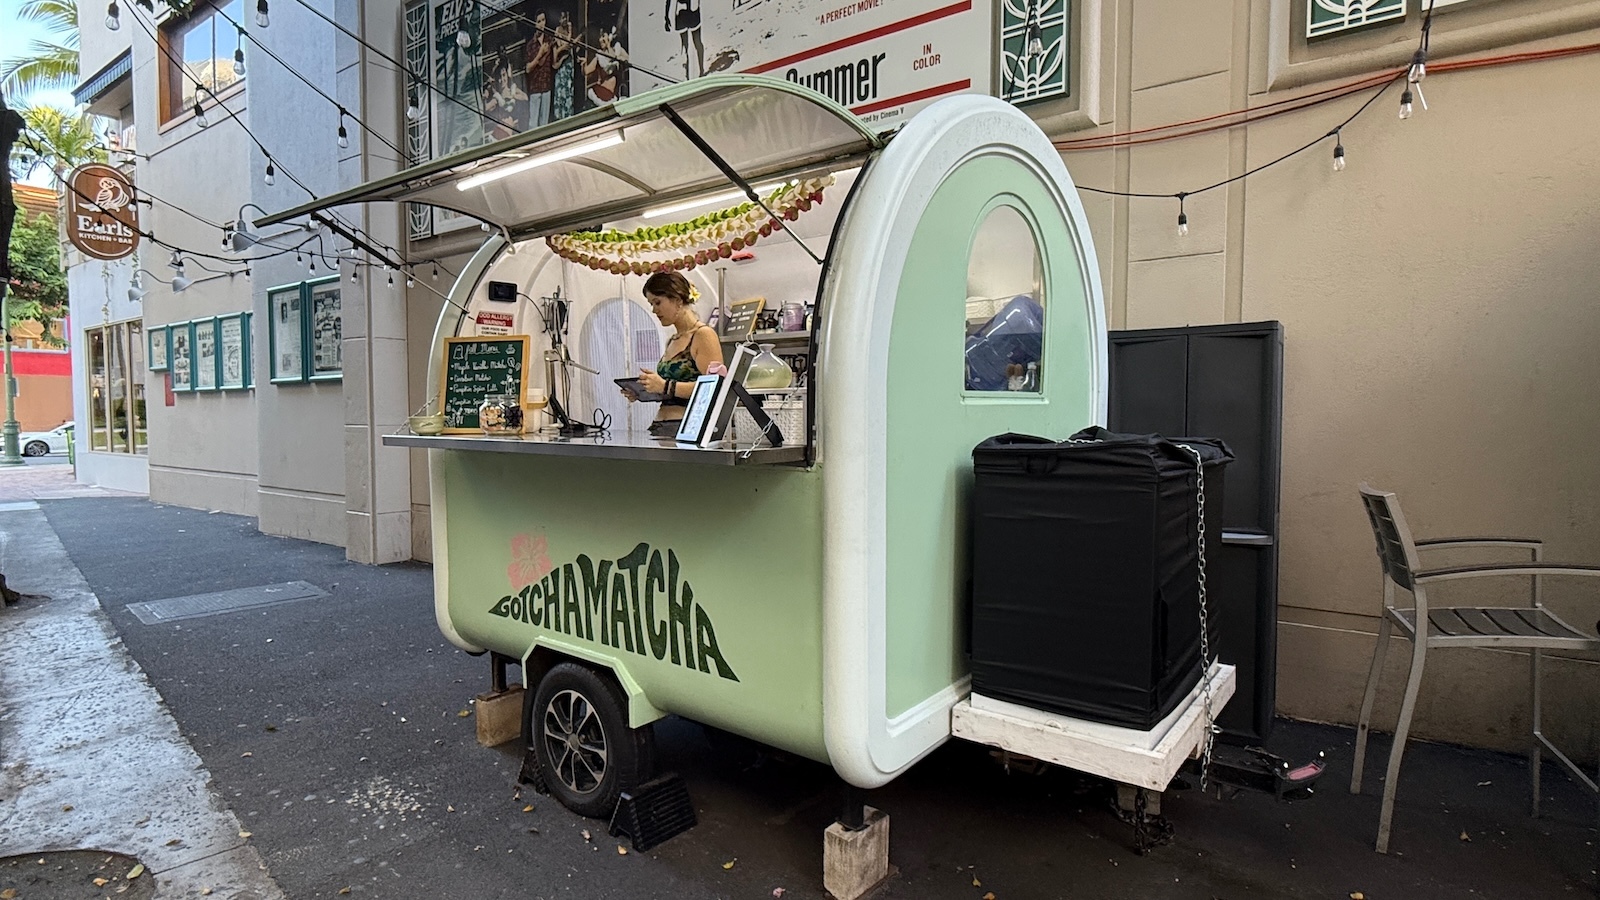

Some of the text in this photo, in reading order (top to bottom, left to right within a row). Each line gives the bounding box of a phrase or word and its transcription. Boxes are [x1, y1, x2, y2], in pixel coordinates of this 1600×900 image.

[826, 4, 856, 23] PERFECT
[923, 43, 932, 55] IN
[913, 54, 941, 71] COLOR
[880, 110, 899, 119] Cinema
[78, 232, 133, 245] KITCHEN BAR
